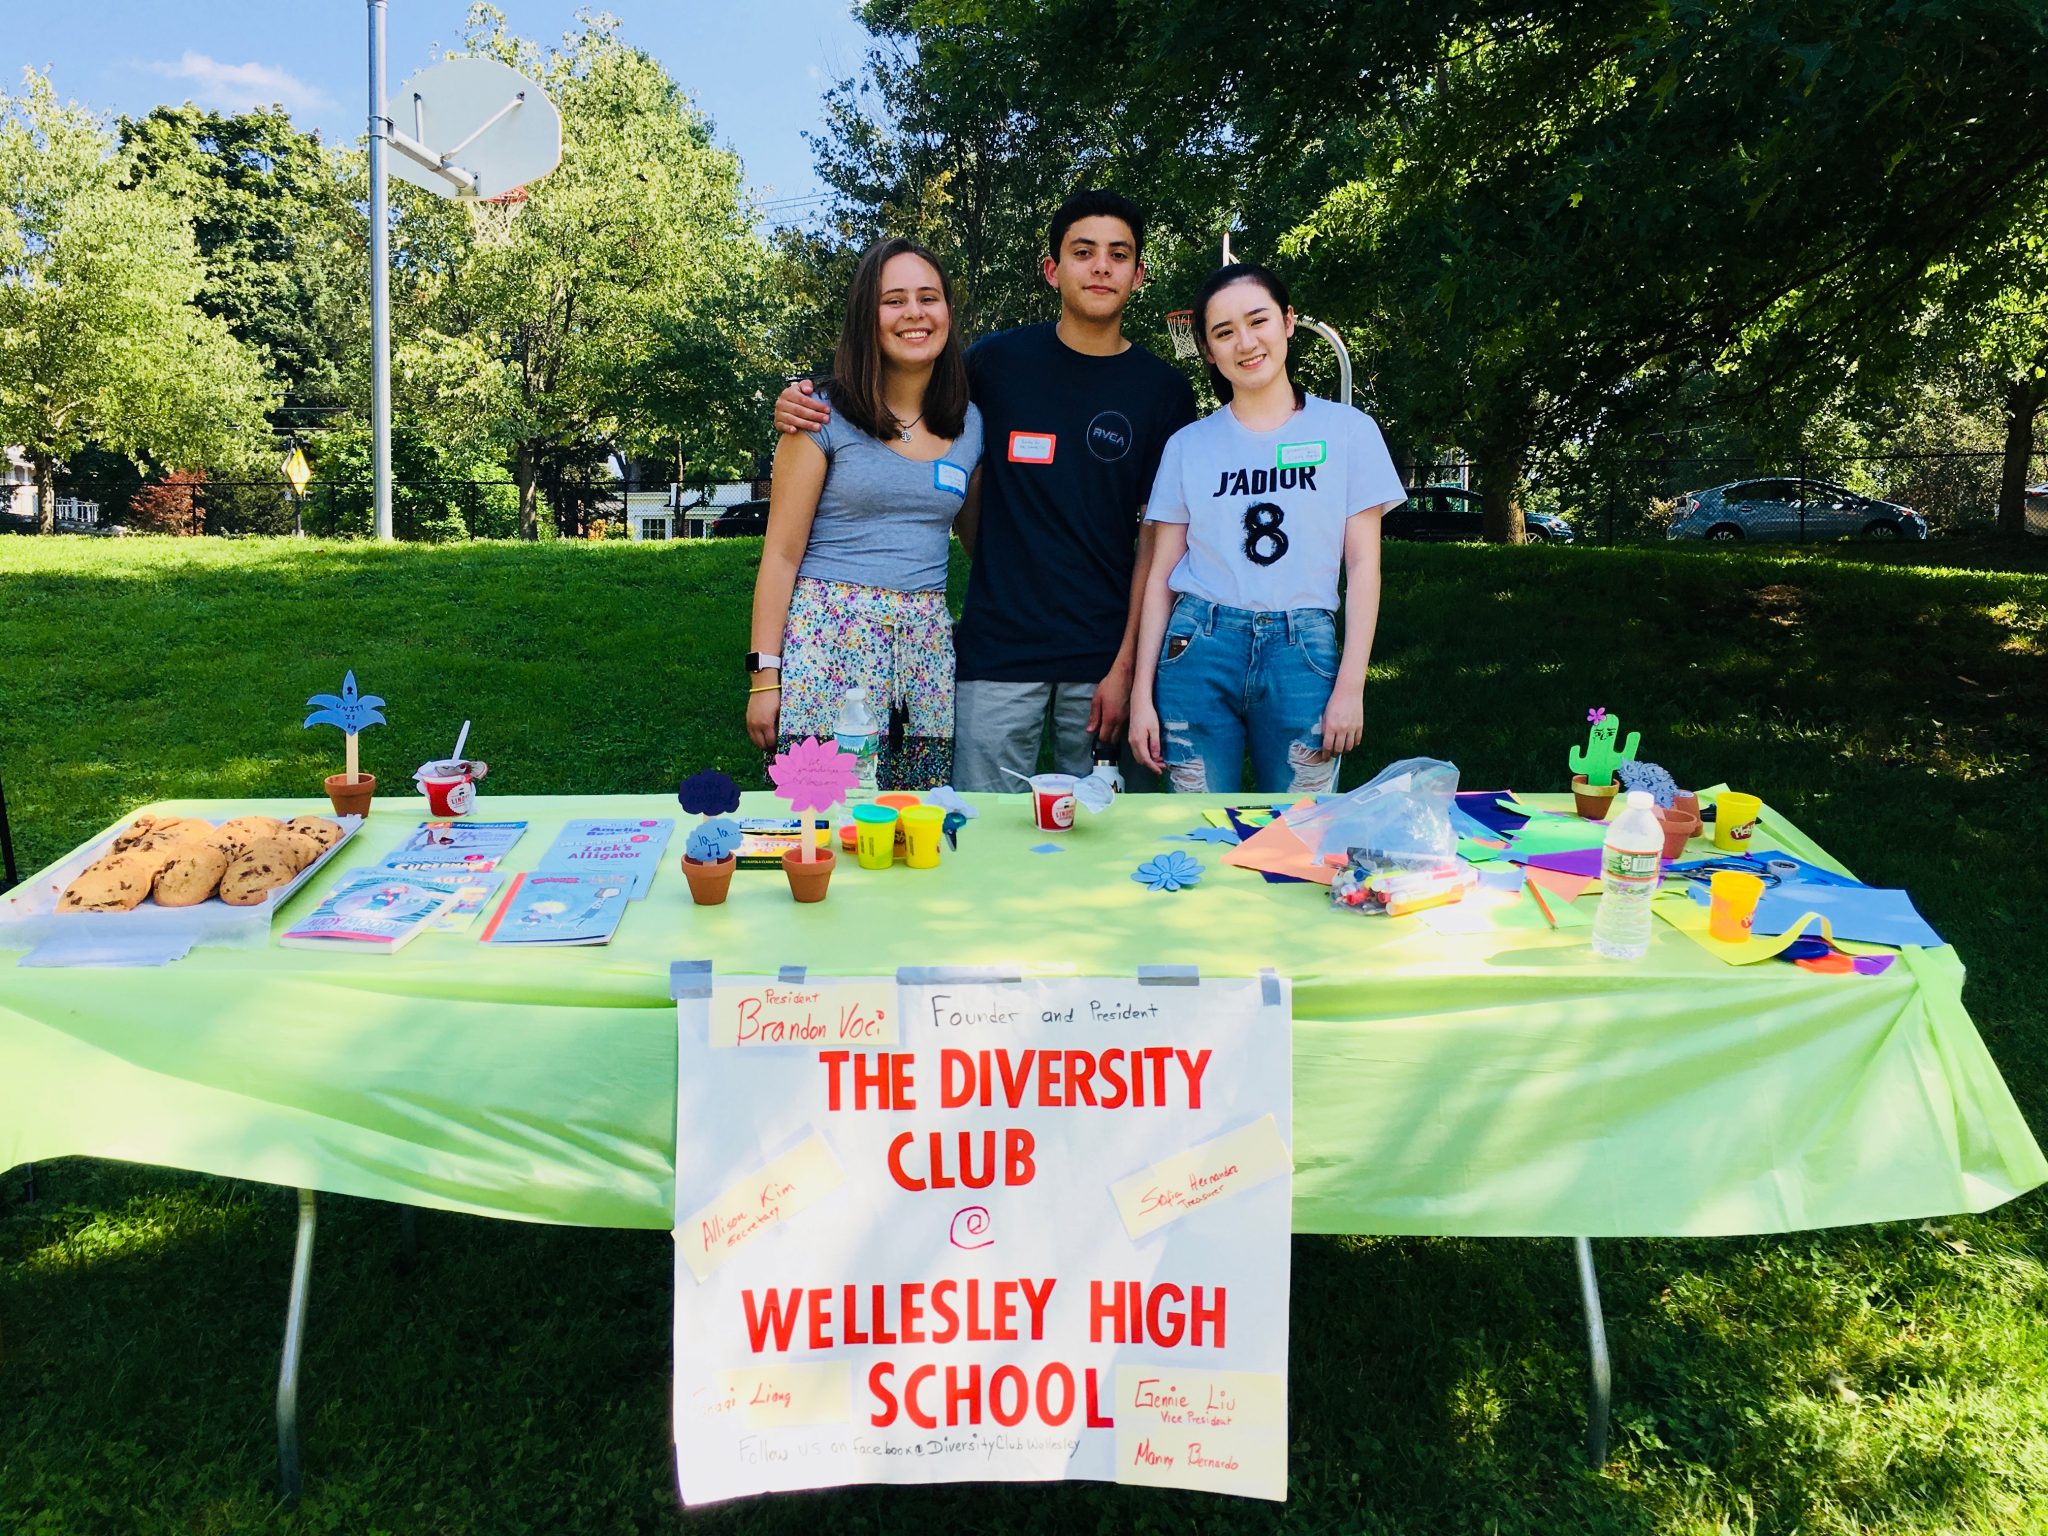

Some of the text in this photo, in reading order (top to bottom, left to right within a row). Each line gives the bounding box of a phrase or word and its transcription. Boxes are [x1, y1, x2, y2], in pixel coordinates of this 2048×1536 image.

[1213, 466, 1316, 497] J'ADIOR
[1241, 502, 1289, 566] 8
[568, 852, 642, 860] Alligator
[584, 844, 633, 852] Zack's
[764, 988, 820, 1004] President
[932, 995, 1159, 1027] Founder and President
[738, 998, 885, 1047] Brandon Voci
[819, 1047, 1213, 1111] THE DIVERSITY
[887, 1128, 1037, 1192] CLUB
[702, 1183, 796, 1253] Allison Kim
[949, 1205, 995, 1250] @
[741, 1277, 1227, 1353] WELLESLEY HIGH
[868, 1361, 1115, 1429] SCHOOL
[1160, 1410, 1183, 1424] Vice
[738, 1434, 789, 1465] Follow
